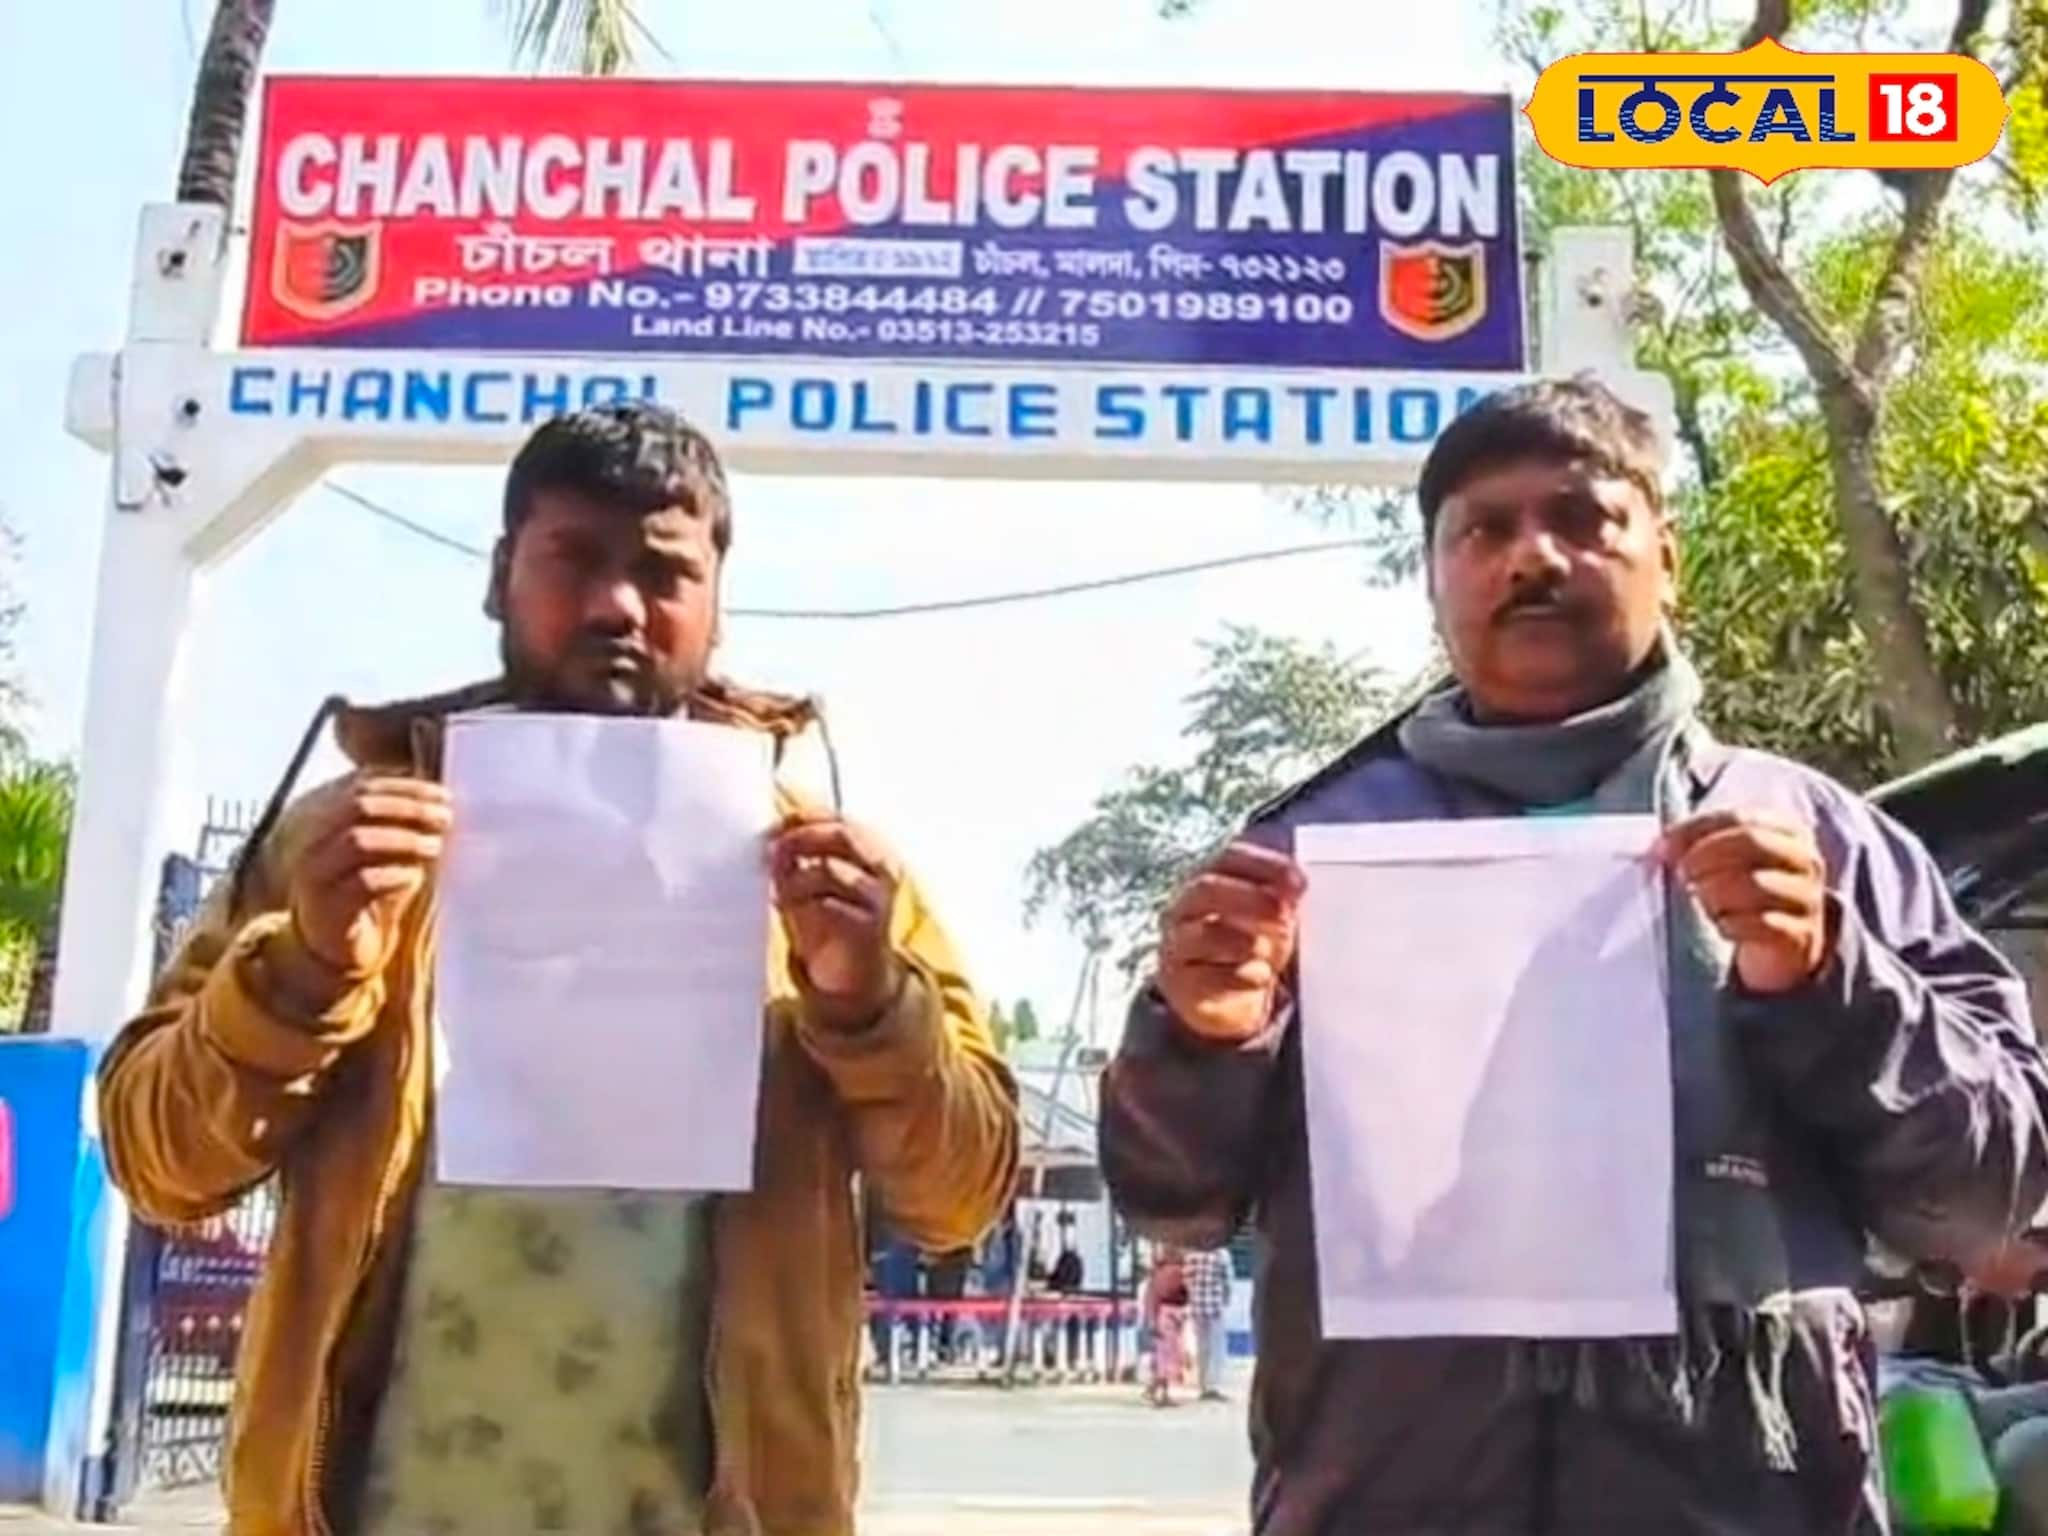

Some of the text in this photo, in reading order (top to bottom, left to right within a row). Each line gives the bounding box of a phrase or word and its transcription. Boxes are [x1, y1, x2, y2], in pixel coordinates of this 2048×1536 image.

[278, 134, 1498, 238] CHANCHAL POLICE STATION
[638, 233, 777, 278] থানা
[415, 278, 572, 307] Phone
[704, 282, 997, 317] 9733844484
[1058, 288, 1353, 324] 7501989100
[632, 314, 713, 337] Land
[723, 315, 792, 340] Line
[877, 319, 1100, 347] 03513-253215
[728, 375, 1058, 438] POLICE
[1094, 385, 1486, 445] STATIO
